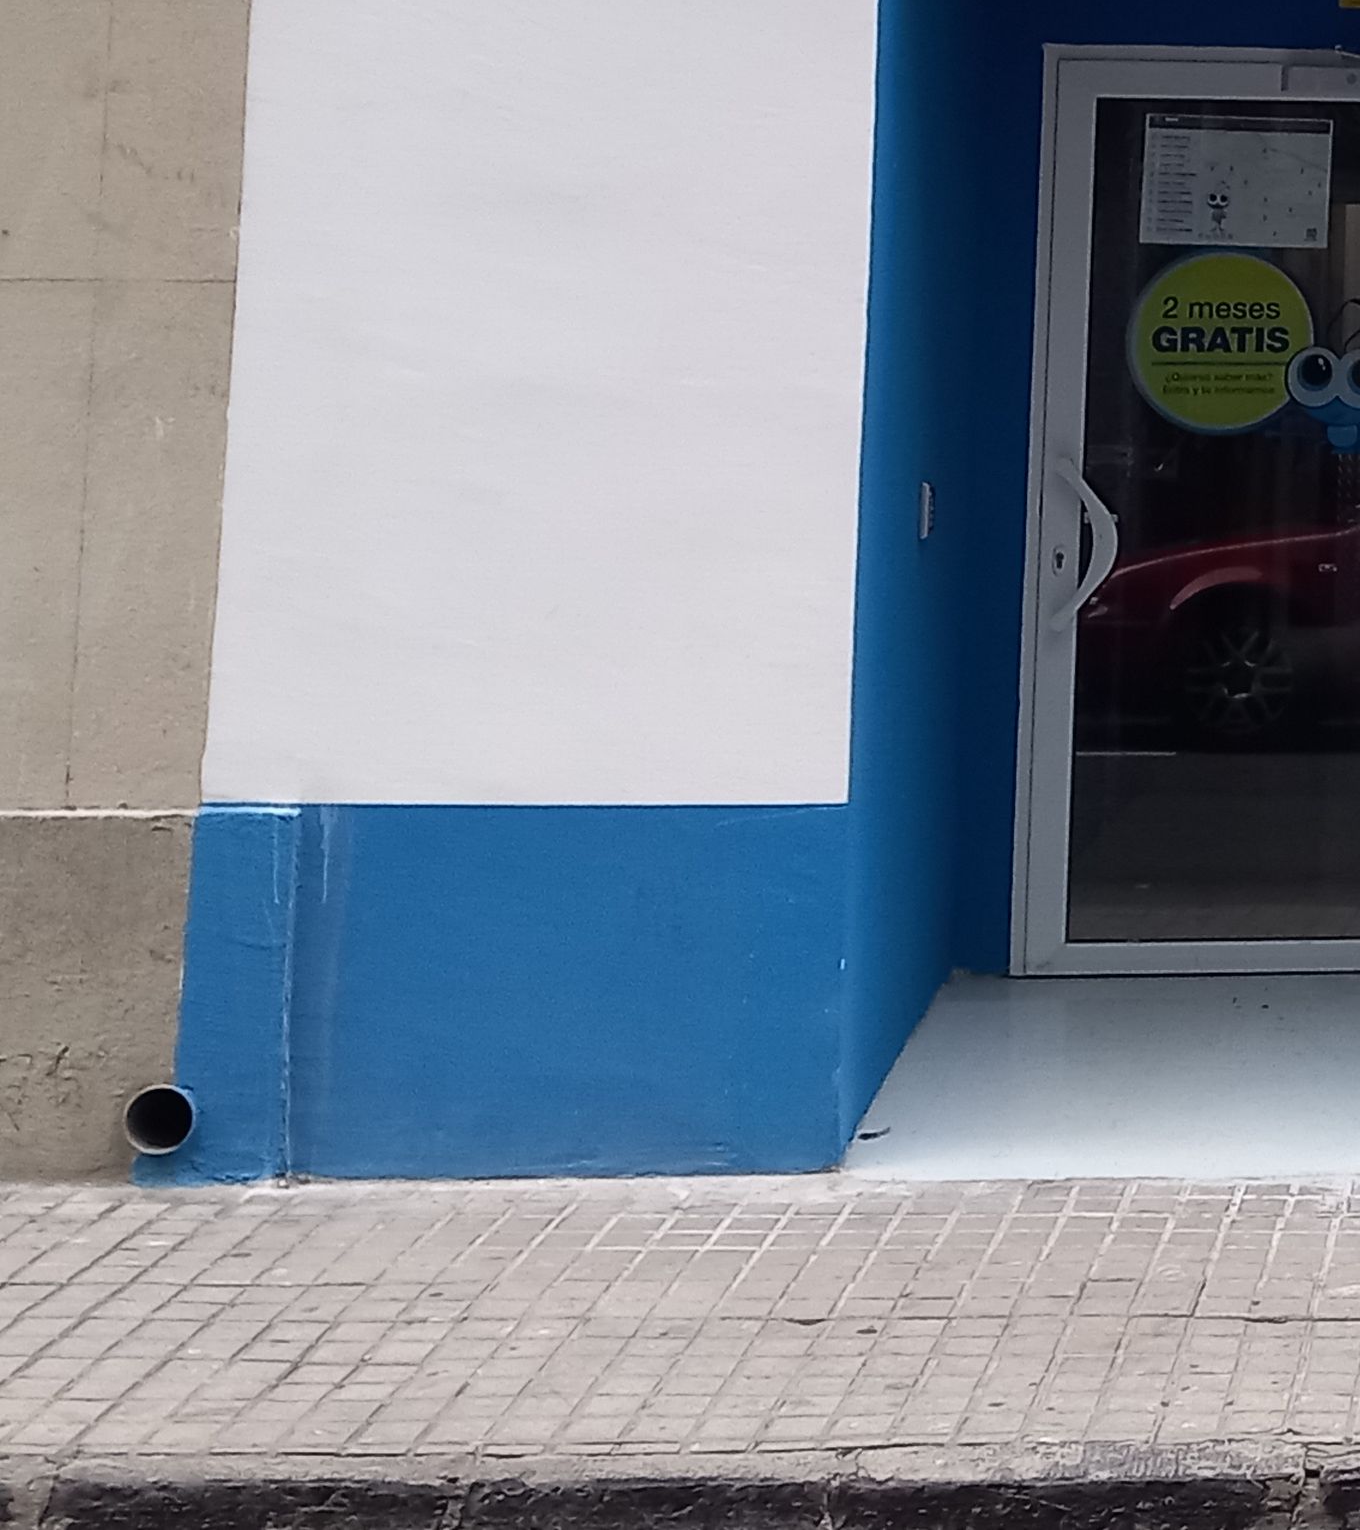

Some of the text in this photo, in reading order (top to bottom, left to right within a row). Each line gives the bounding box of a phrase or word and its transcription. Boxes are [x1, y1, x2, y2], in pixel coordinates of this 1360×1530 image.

[1162, 296, 1281, 320] 2 meses
[1151, 325, 1290, 354] GRATIS
